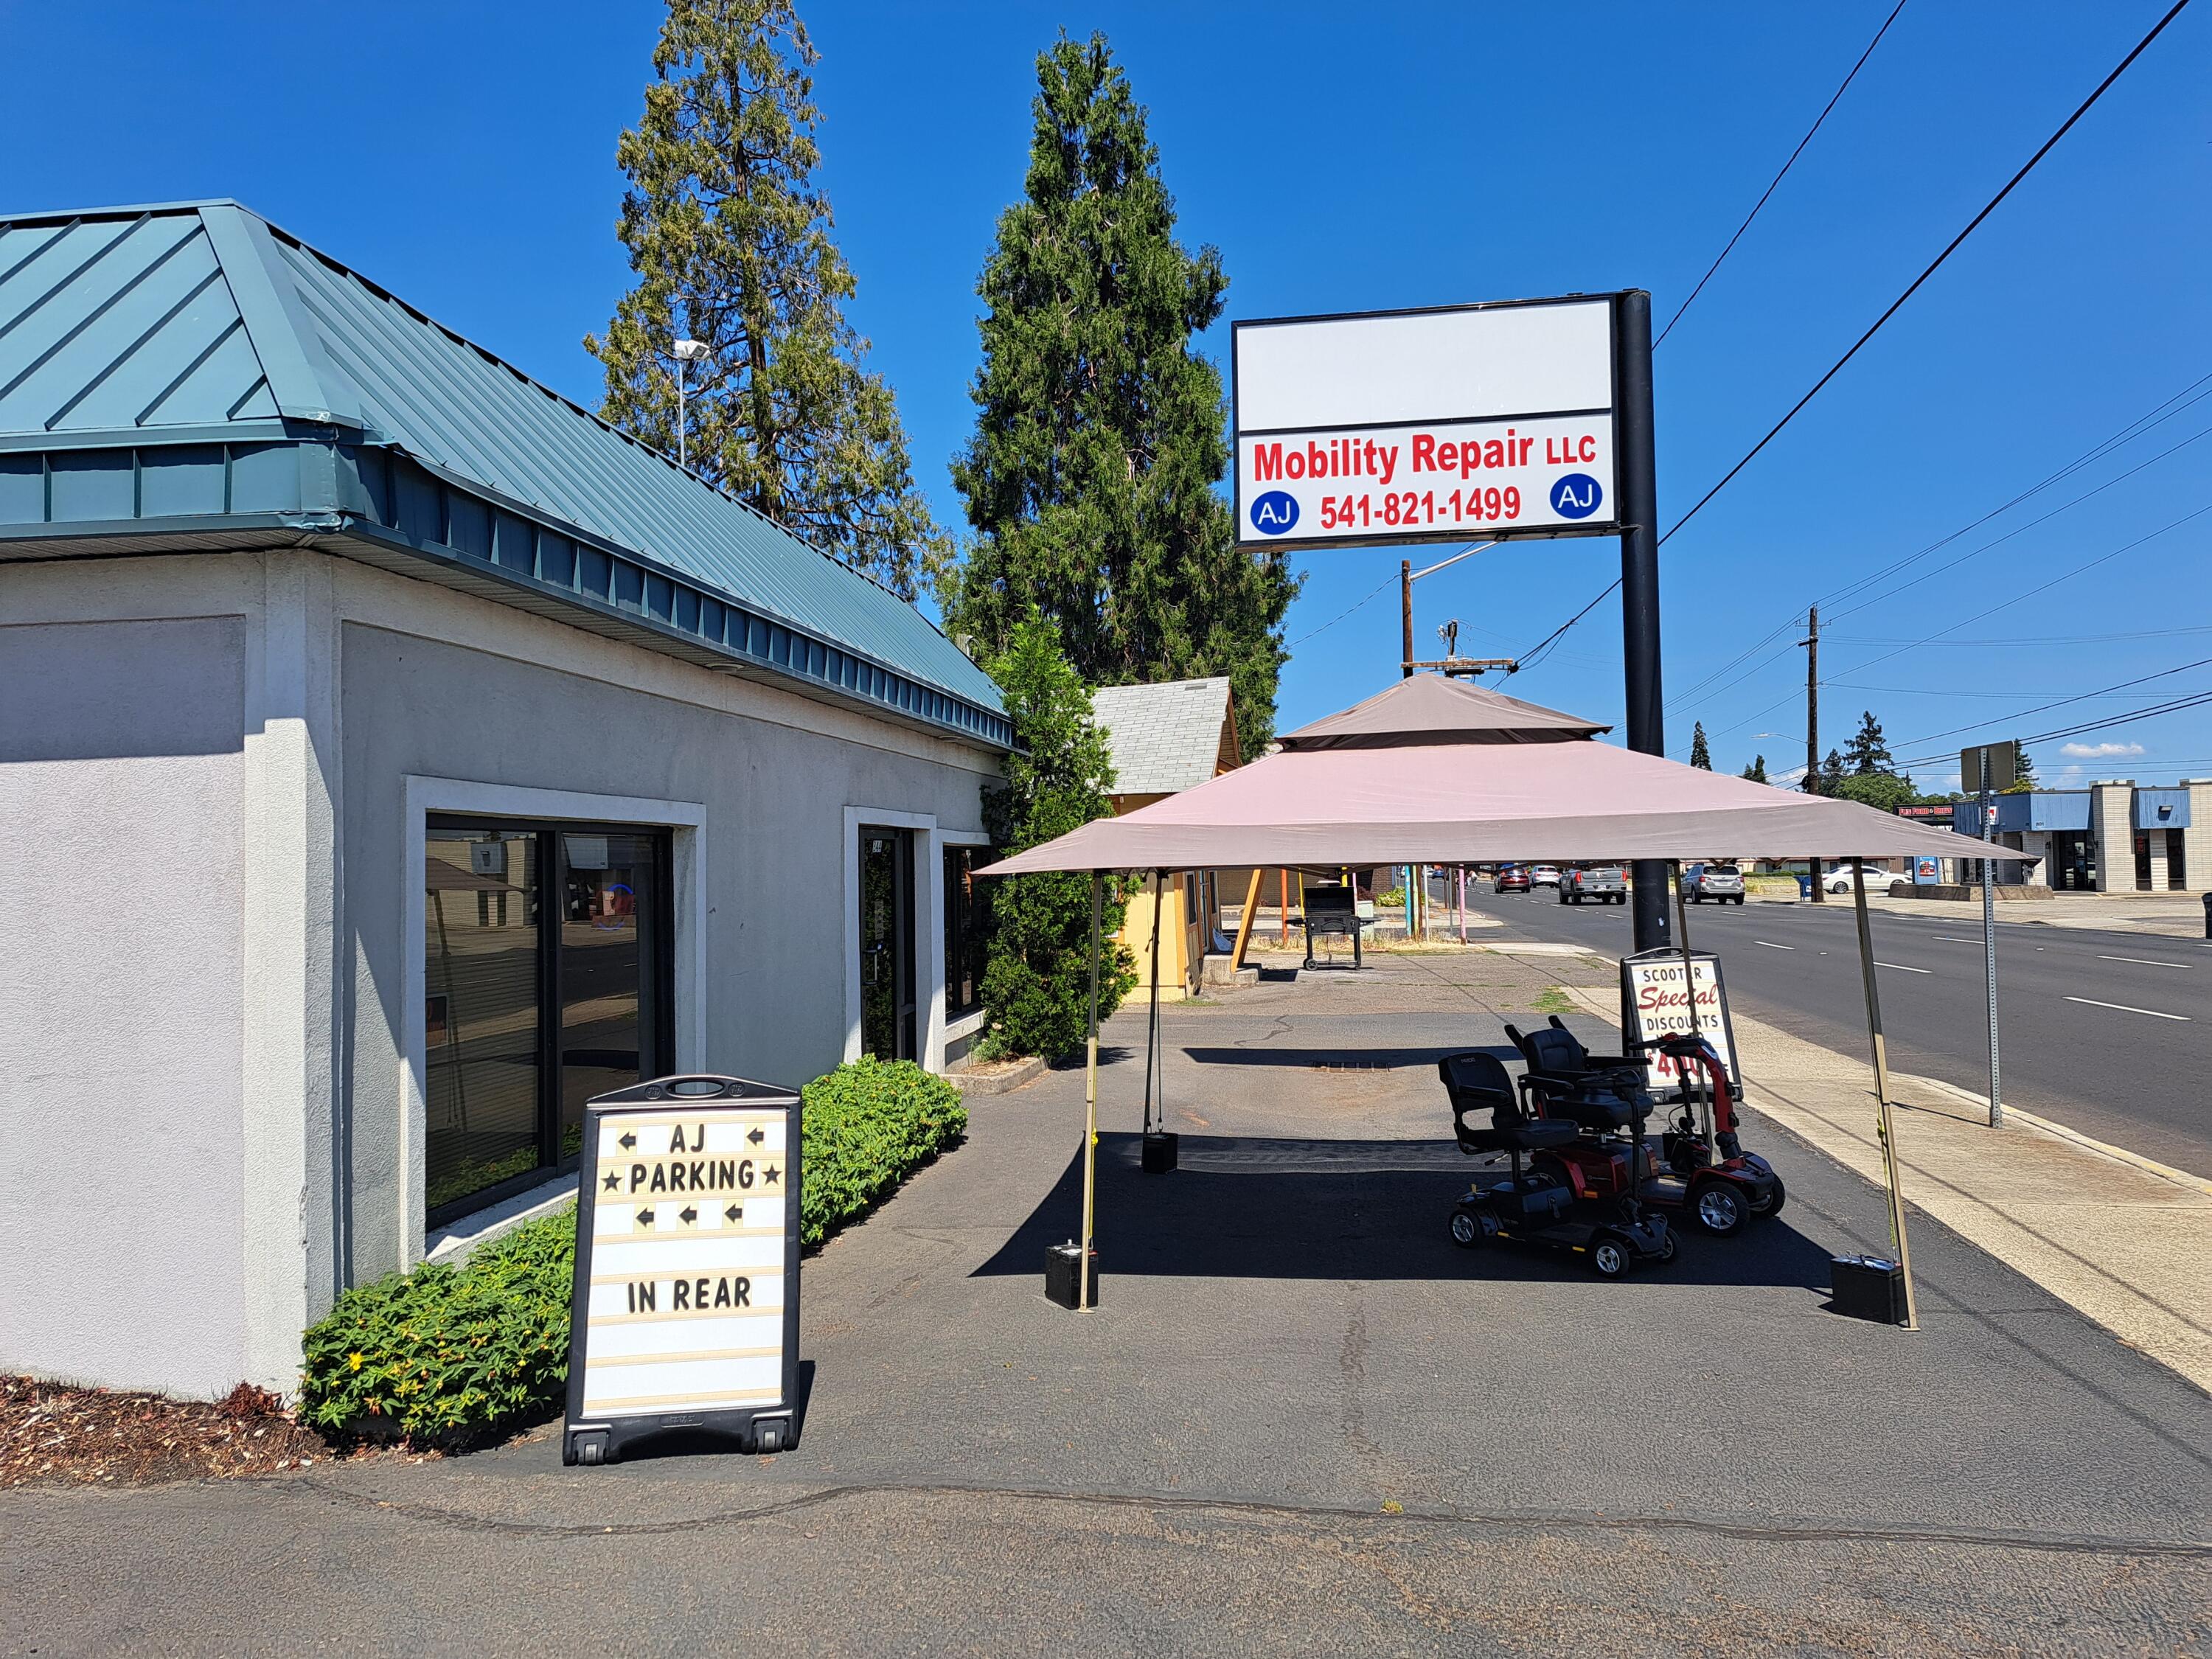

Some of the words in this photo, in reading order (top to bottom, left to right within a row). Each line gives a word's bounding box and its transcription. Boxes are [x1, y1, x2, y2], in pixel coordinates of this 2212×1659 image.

[1254, 438, 1399, 485] Mobility
[1412, 428, 1534, 480] Repair
[1546, 435, 1596, 465] LLC
[1321, 487, 1521, 529] 541-821-1499
[1558, 484, 1593, 508] AJ
[1258, 501, 1290, 524] AJ
[1643, 967, 1703, 983] SCOOTR
[1637, 984, 1719, 1013] Specal
[670, 1124, 705, 1153] AJ
[630, 1160, 754, 1194] PARKING
[628, 1281, 655, 1313] IN
[672, 1276, 751, 1310] REAR
